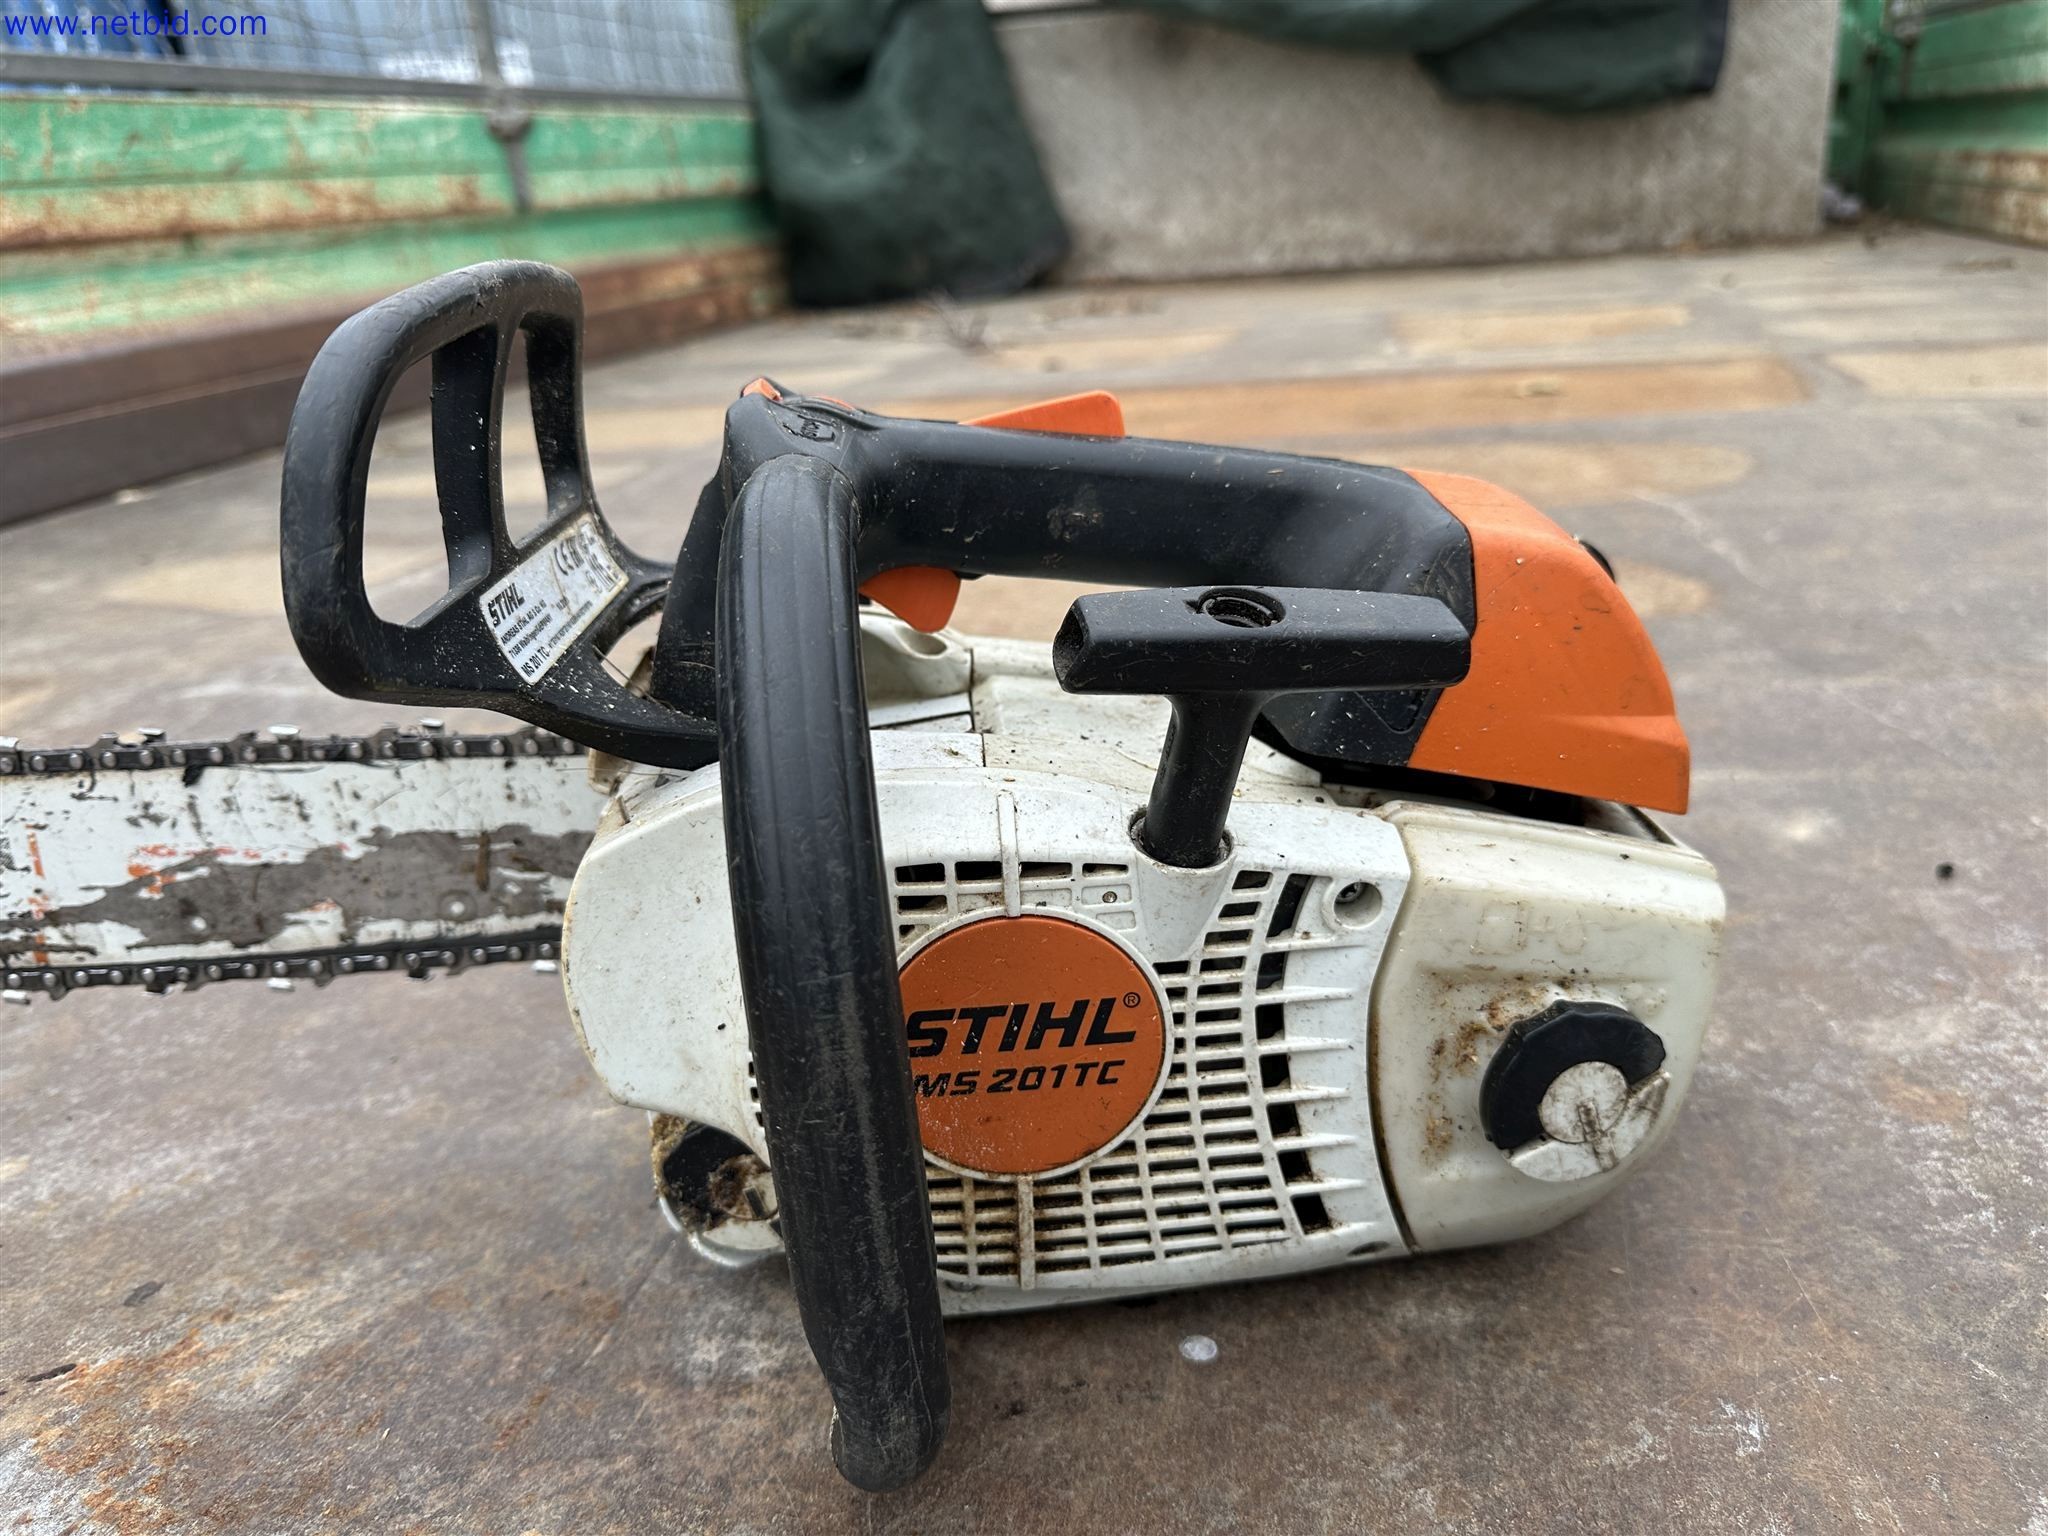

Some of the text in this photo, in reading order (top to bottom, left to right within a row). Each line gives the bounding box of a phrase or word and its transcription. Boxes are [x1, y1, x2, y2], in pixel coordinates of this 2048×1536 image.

[488, 583, 525, 628] STIHL
[501, 624, 520, 646] ANDREAS
[521, 662, 536, 678] MS
[529, 652, 544, 670] 201
[906, 998, 1137, 1058] STIHL
[914, 1070, 981, 1098] MS
